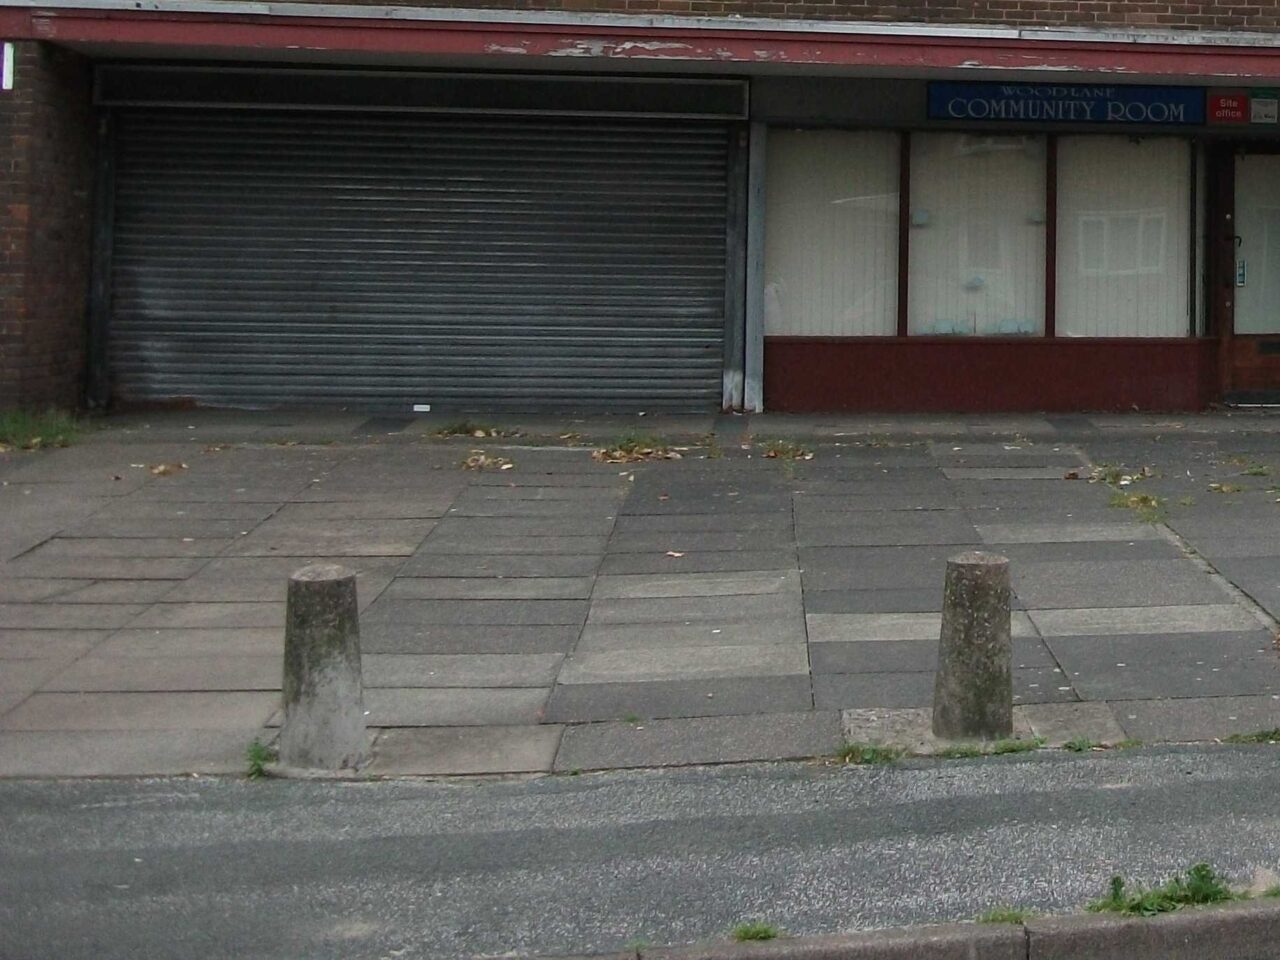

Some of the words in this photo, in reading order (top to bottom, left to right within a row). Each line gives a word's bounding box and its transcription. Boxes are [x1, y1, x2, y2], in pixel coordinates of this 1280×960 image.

[1219, 98, 1239, 108] Site
[948, 97, 1096, 120] COMMUNITY
[1106, 100, 1185, 122] ROOM
[1215, 108, 1242, 118] office
